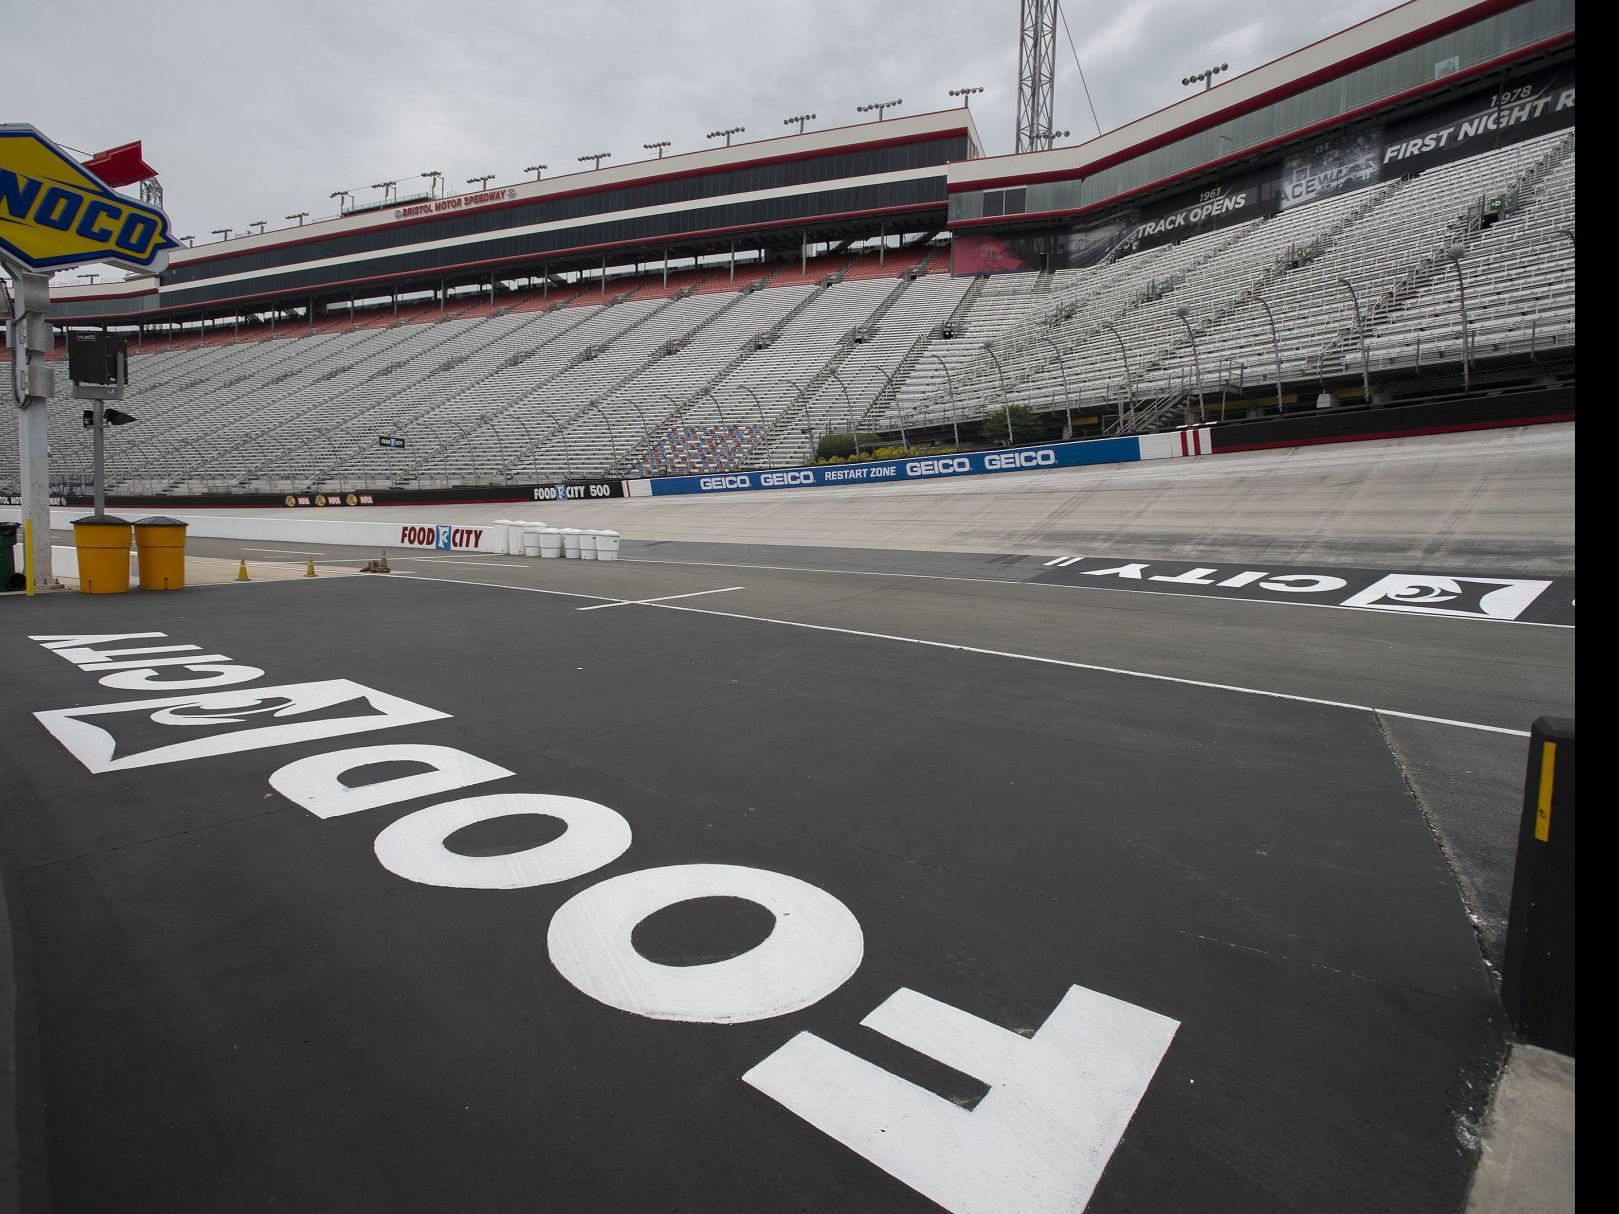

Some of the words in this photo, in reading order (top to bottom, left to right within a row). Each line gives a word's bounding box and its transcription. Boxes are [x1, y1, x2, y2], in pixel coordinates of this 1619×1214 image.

[1491, 85, 1532, 107] 1978
[1383, 126, 1455, 164] FIRST
[1457, 96, 1551, 141] NIGHT
[402, 206, 433, 217] BRISTOL
[435, 199, 462, 212] MOTOR
[464, 190, 506, 206] SPEEDWAY
[1200, 187, 1221, 202] 1961
[1137, 211, 1187, 239] TRACK
[1189, 193, 1247, 222] OPENS
[700, 475, 750, 490] GEICO
[760, 471, 814, 487] GEICO
[825, 468, 868, 481] RESTART
[870, 466, 896, 478] ZONE
[906, 458, 971, 476] GEICO
[984, 449, 1056, 470] GEICO
[533, 487, 556, 500] FOOD
[566, 485, 585, 498] CITY
[589, 484, 610, 497] 500
[400, 526, 435, 545] FOOD
[451, 528, 483, 548] CITY
[1079, 563, 1347, 593] CITY
[27, 632, 265, 690] CITY
[268, 744, 1181, 1214] FOOD
